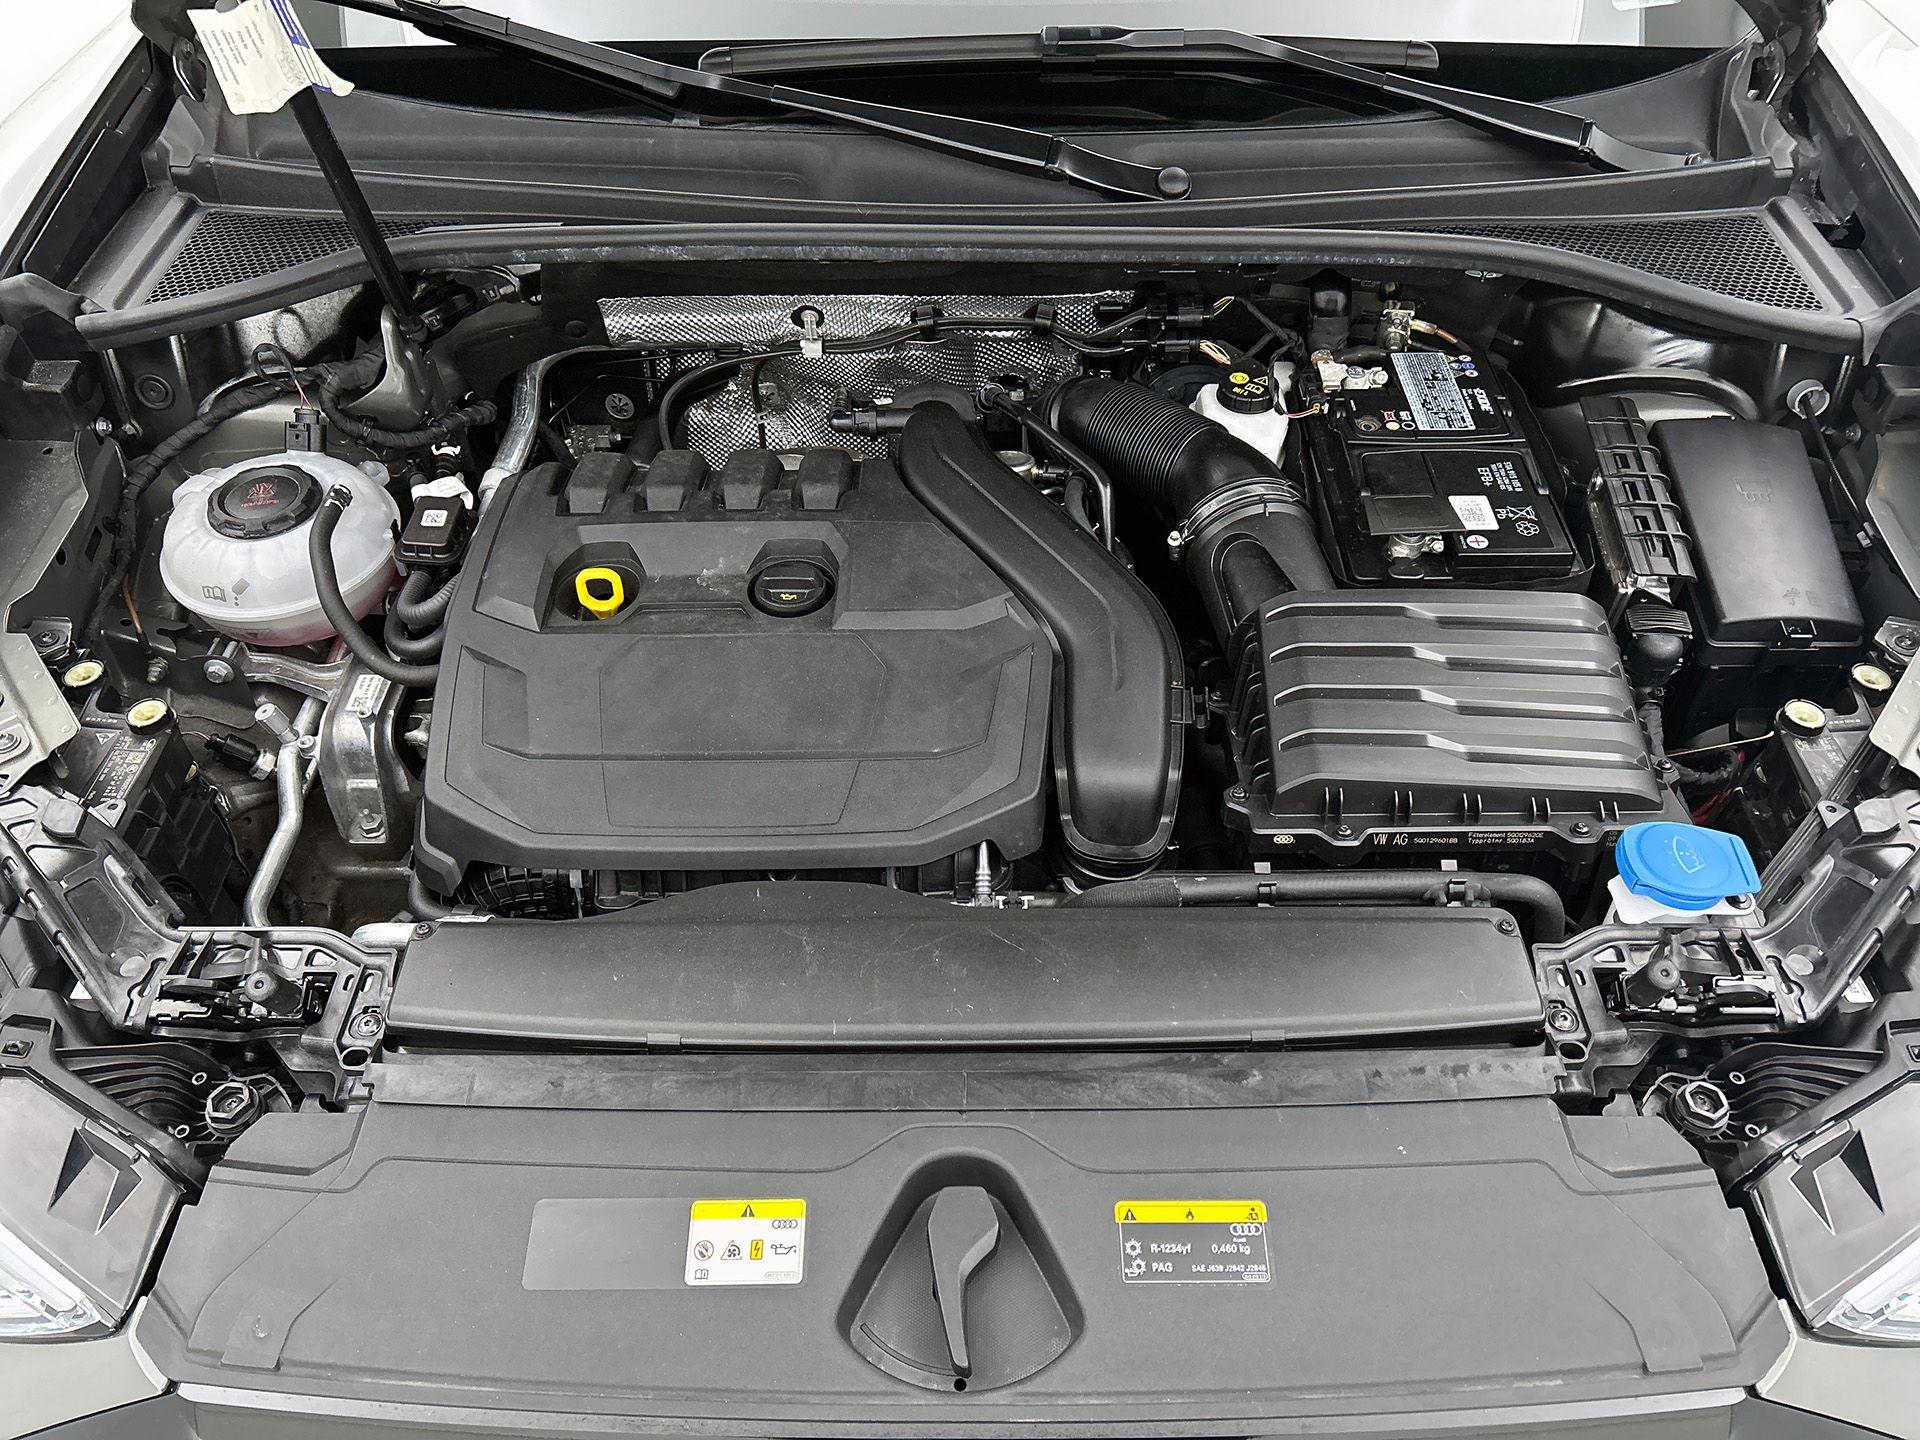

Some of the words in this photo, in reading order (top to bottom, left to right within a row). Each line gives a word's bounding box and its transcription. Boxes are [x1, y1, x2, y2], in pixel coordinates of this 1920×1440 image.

[1476, 467, 1494, 487] EFB+
[1494, 508, 1507, 520] Pb
[1373, 833, 1388, 845] VW
[1392, 833, 1409, 845] AG
[1150, 1243, 1192, 1255] R-1234yf
[1211, 1243, 1237, 1255] 0,460
[1239, 1243, 1251, 1255] kg
[1151, 1262, 1173, 1273] PAG
[1191, 1264, 1206, 1272] SAE
